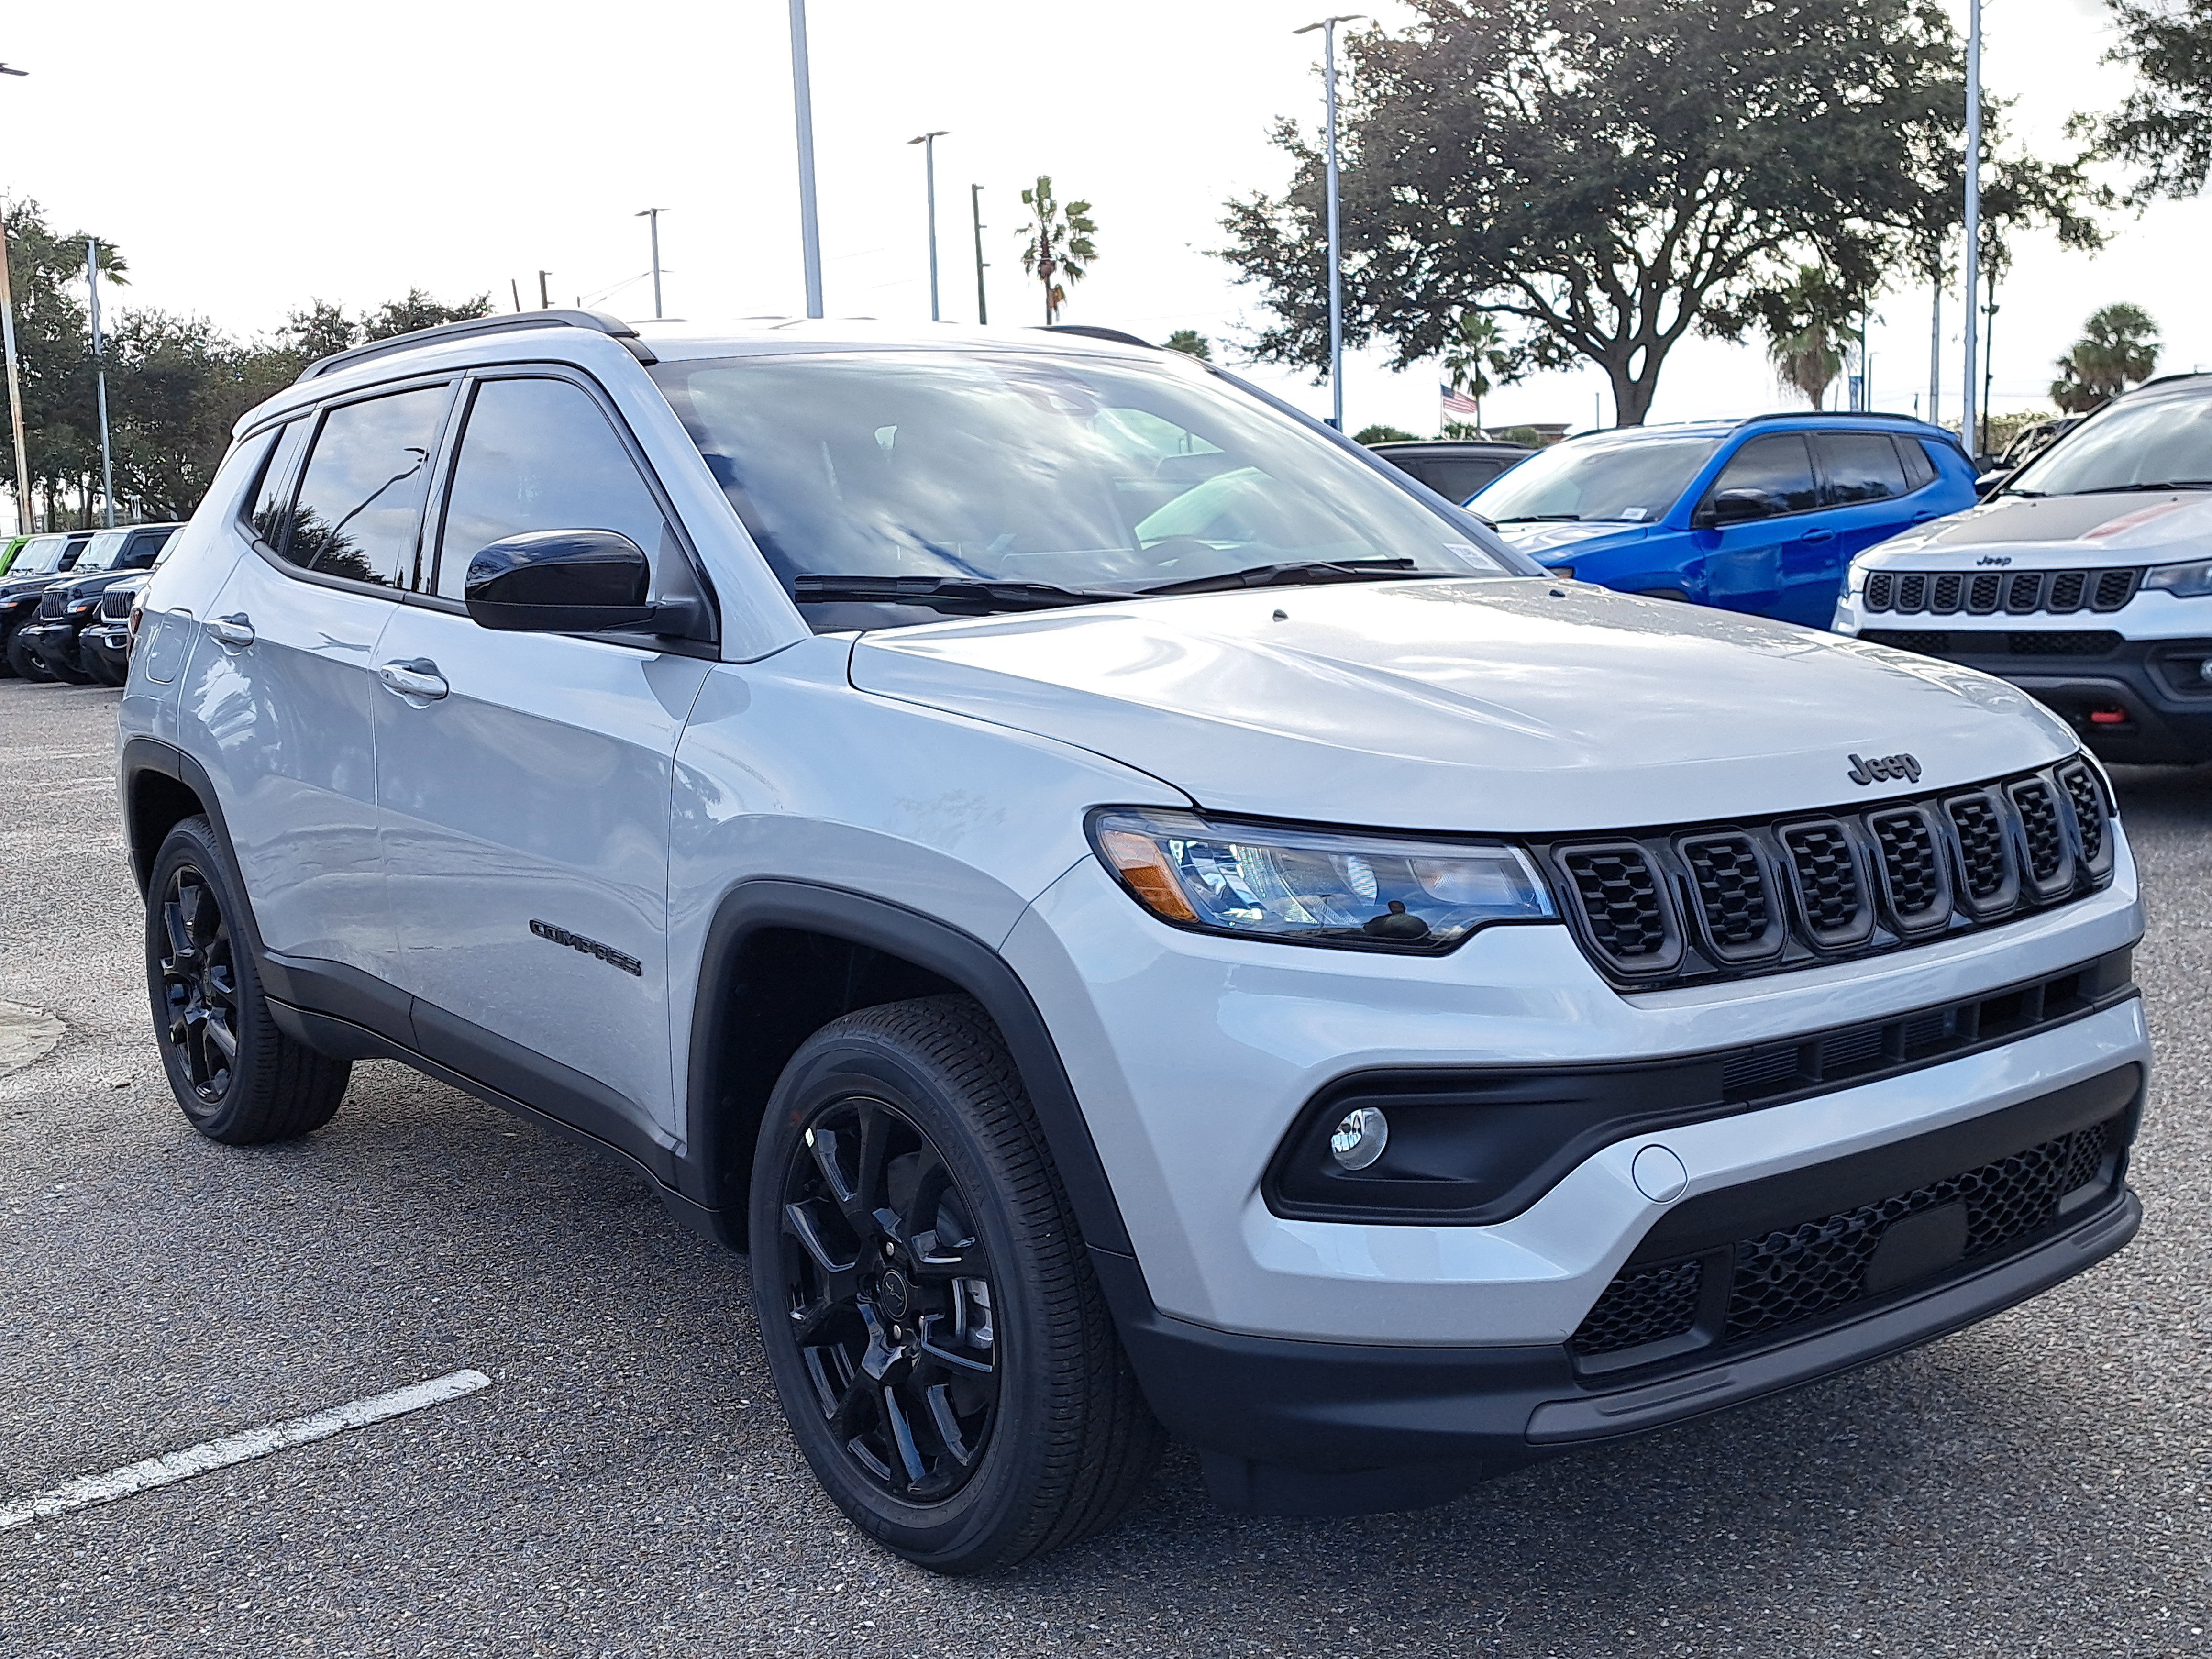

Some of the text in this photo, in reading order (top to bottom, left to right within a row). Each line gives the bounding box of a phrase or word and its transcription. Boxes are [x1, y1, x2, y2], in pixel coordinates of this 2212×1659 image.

[1977, 555, 2012, 567] Jeep
[1847, 753, 1922, 786] Jeep
[529, 918, 642, 977] COMPASS
